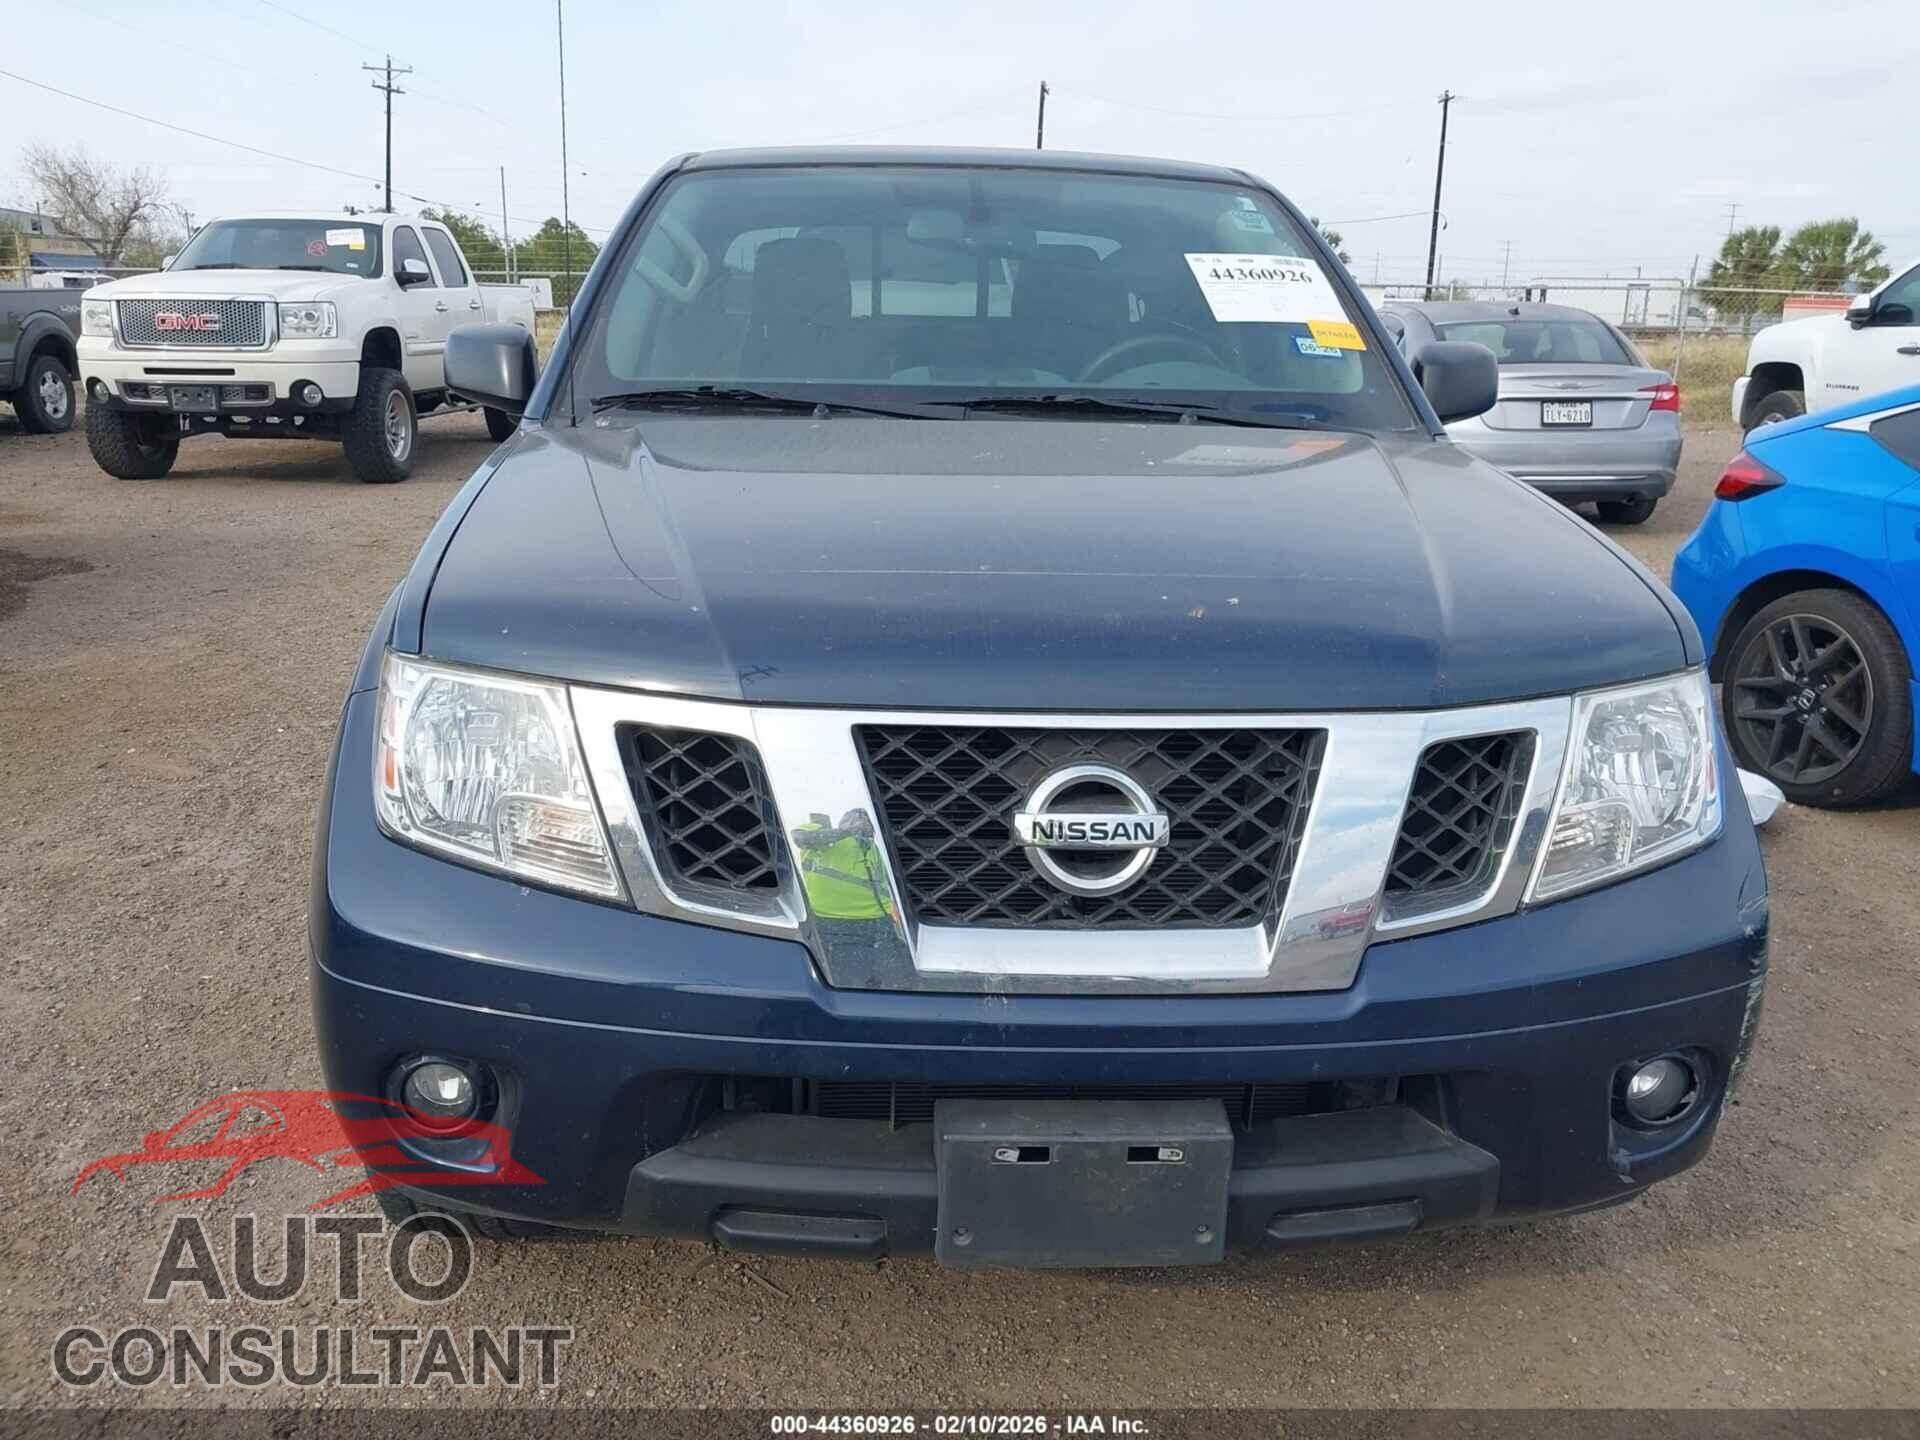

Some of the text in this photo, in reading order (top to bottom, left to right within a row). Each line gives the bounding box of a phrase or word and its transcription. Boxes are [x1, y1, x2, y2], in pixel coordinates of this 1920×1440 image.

[1209, 267, 1313, 283] 44360926
[155, 313, 220, 331] GMC
[1032, 821, 1154, 841] NISSAN
